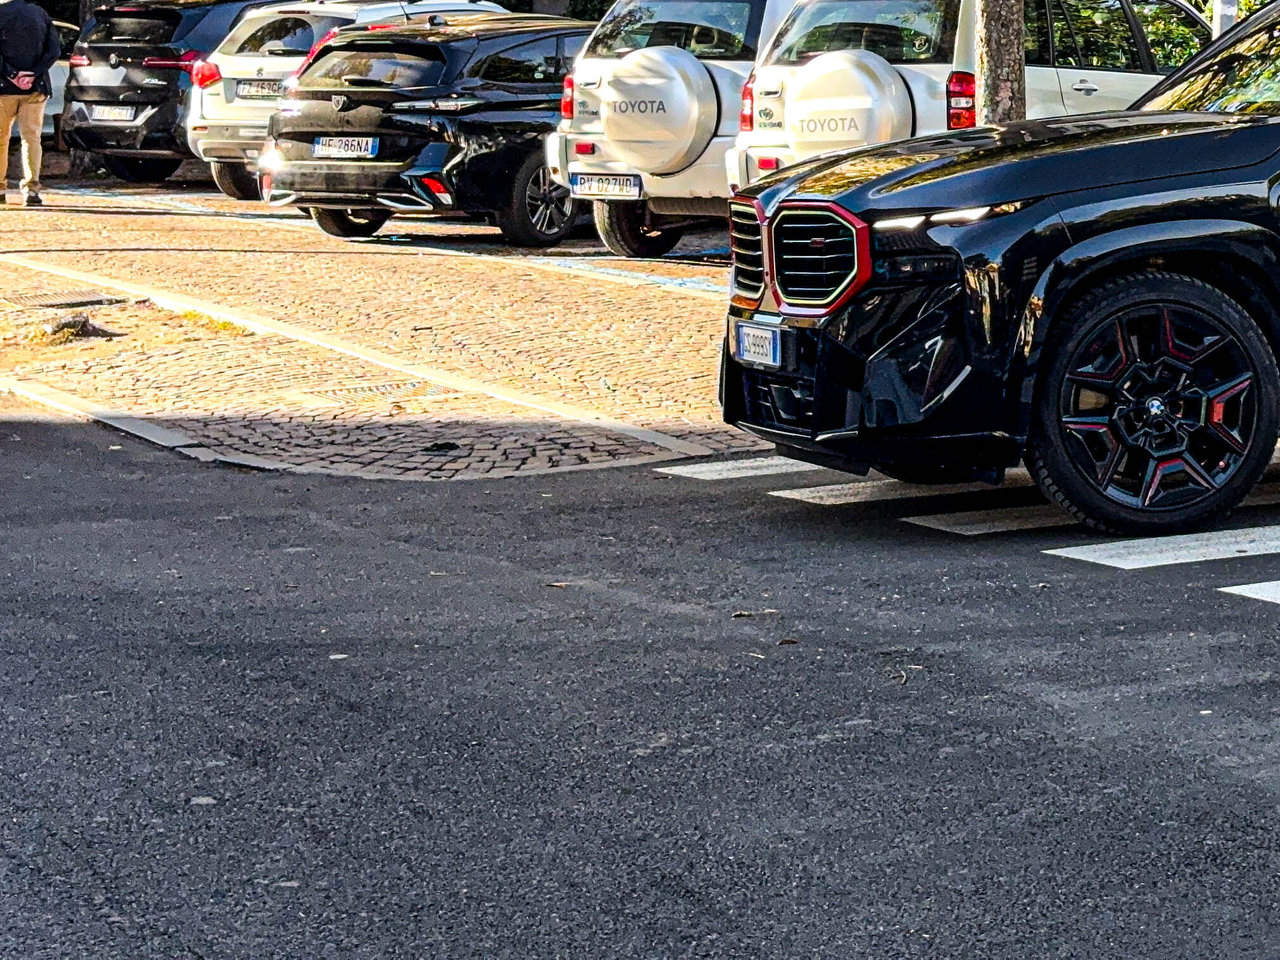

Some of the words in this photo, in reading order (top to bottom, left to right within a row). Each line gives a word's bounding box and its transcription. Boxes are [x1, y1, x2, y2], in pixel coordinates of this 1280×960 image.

[612, 100, 666, 114] TOYOTA
[799, 117, 859, 133] TOYOTA
[338, 139, 369, 153] 286NA
